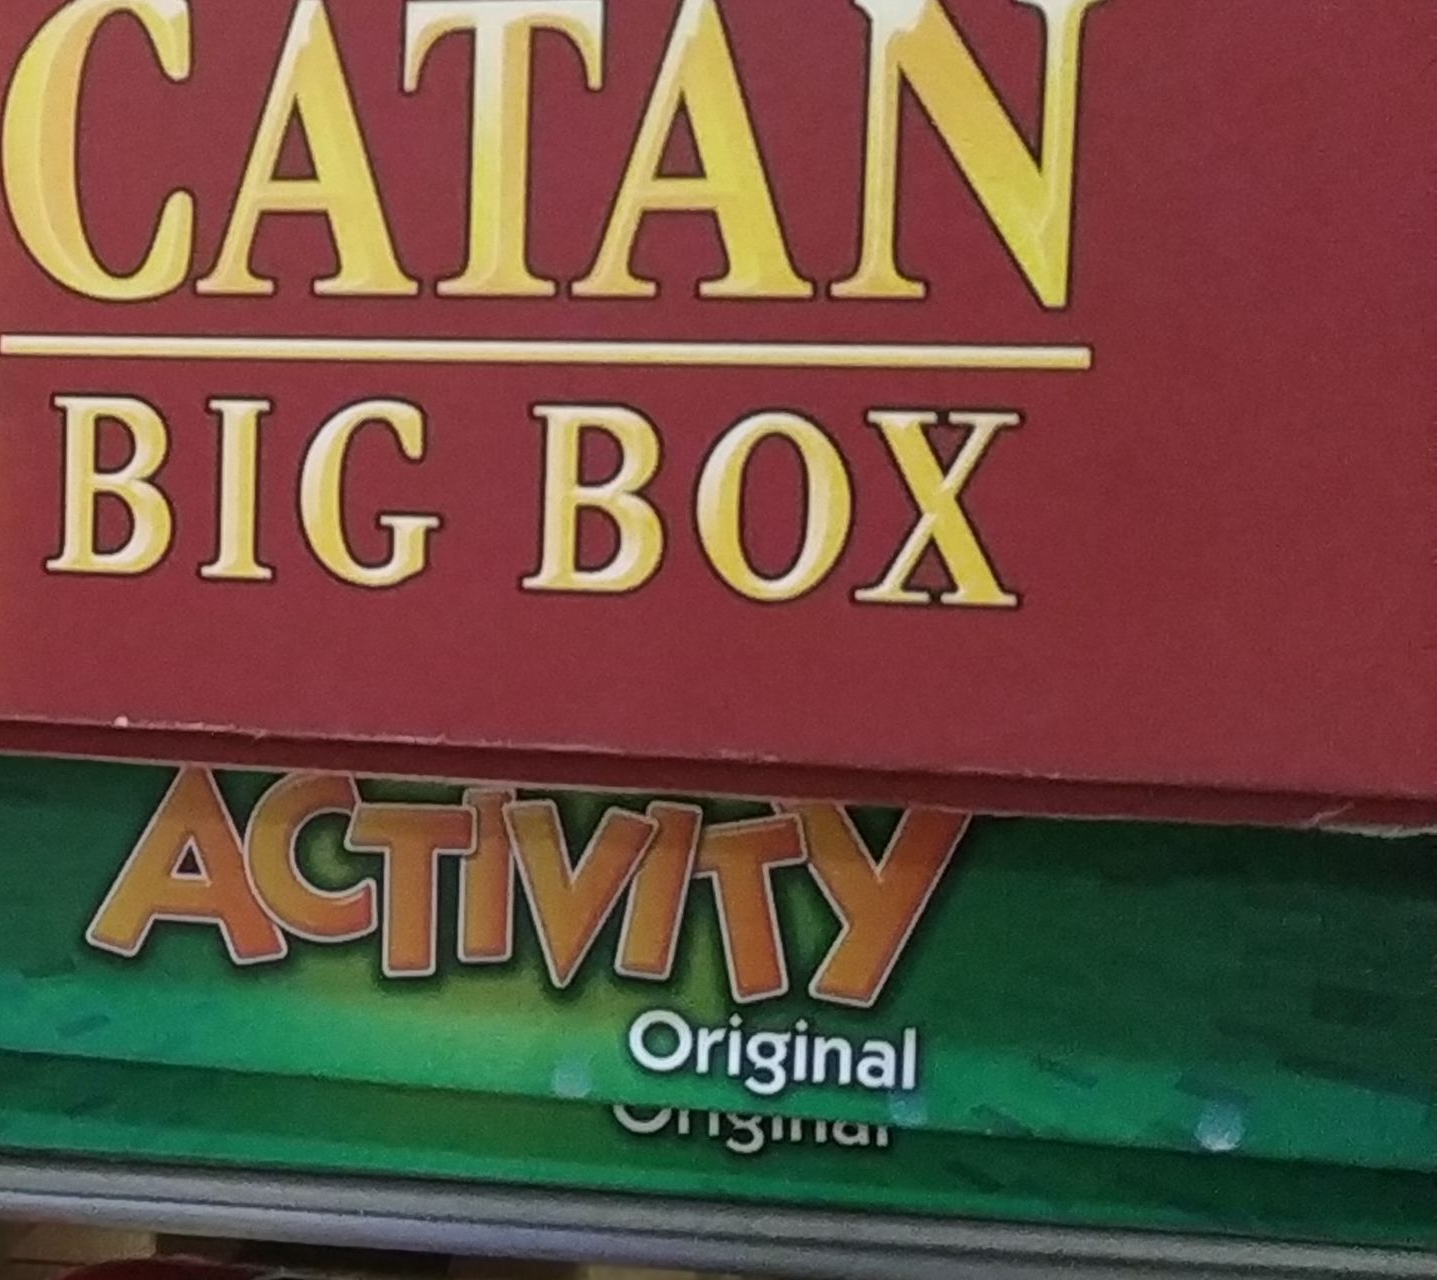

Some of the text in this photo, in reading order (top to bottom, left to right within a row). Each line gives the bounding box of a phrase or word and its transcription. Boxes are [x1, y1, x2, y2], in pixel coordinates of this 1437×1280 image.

[45, 393, 1024, 609] BIG BOX
[87, 764, 971, 1007] ACTIVITY
[628, 1009, 918, 1095] Original
